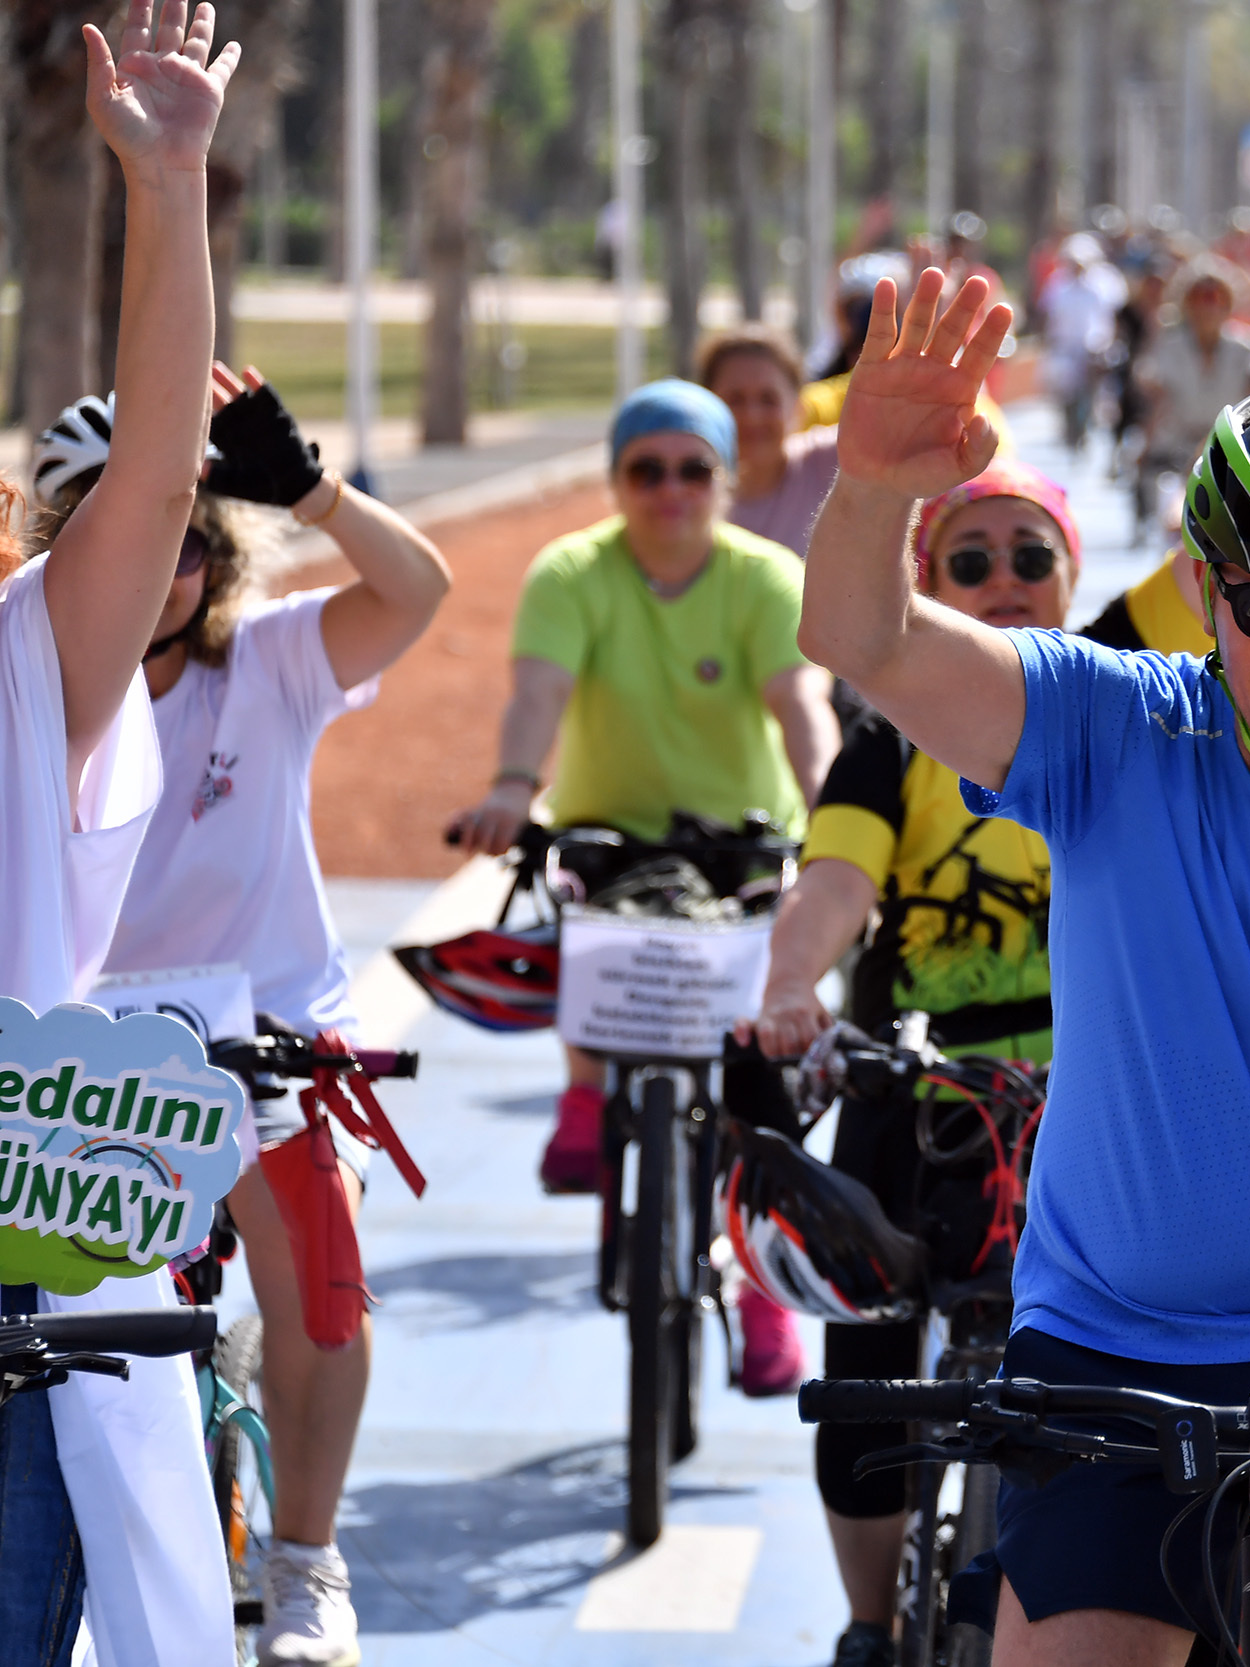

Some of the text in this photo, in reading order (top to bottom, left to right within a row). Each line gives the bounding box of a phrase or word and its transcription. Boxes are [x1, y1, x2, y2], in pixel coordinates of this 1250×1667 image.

[0, 1064, 224, 1148] edalını
[0, 1139, 185, 1255] ÜNYA'yı
[1180, 1439, 1193, 1480] Saramonic
